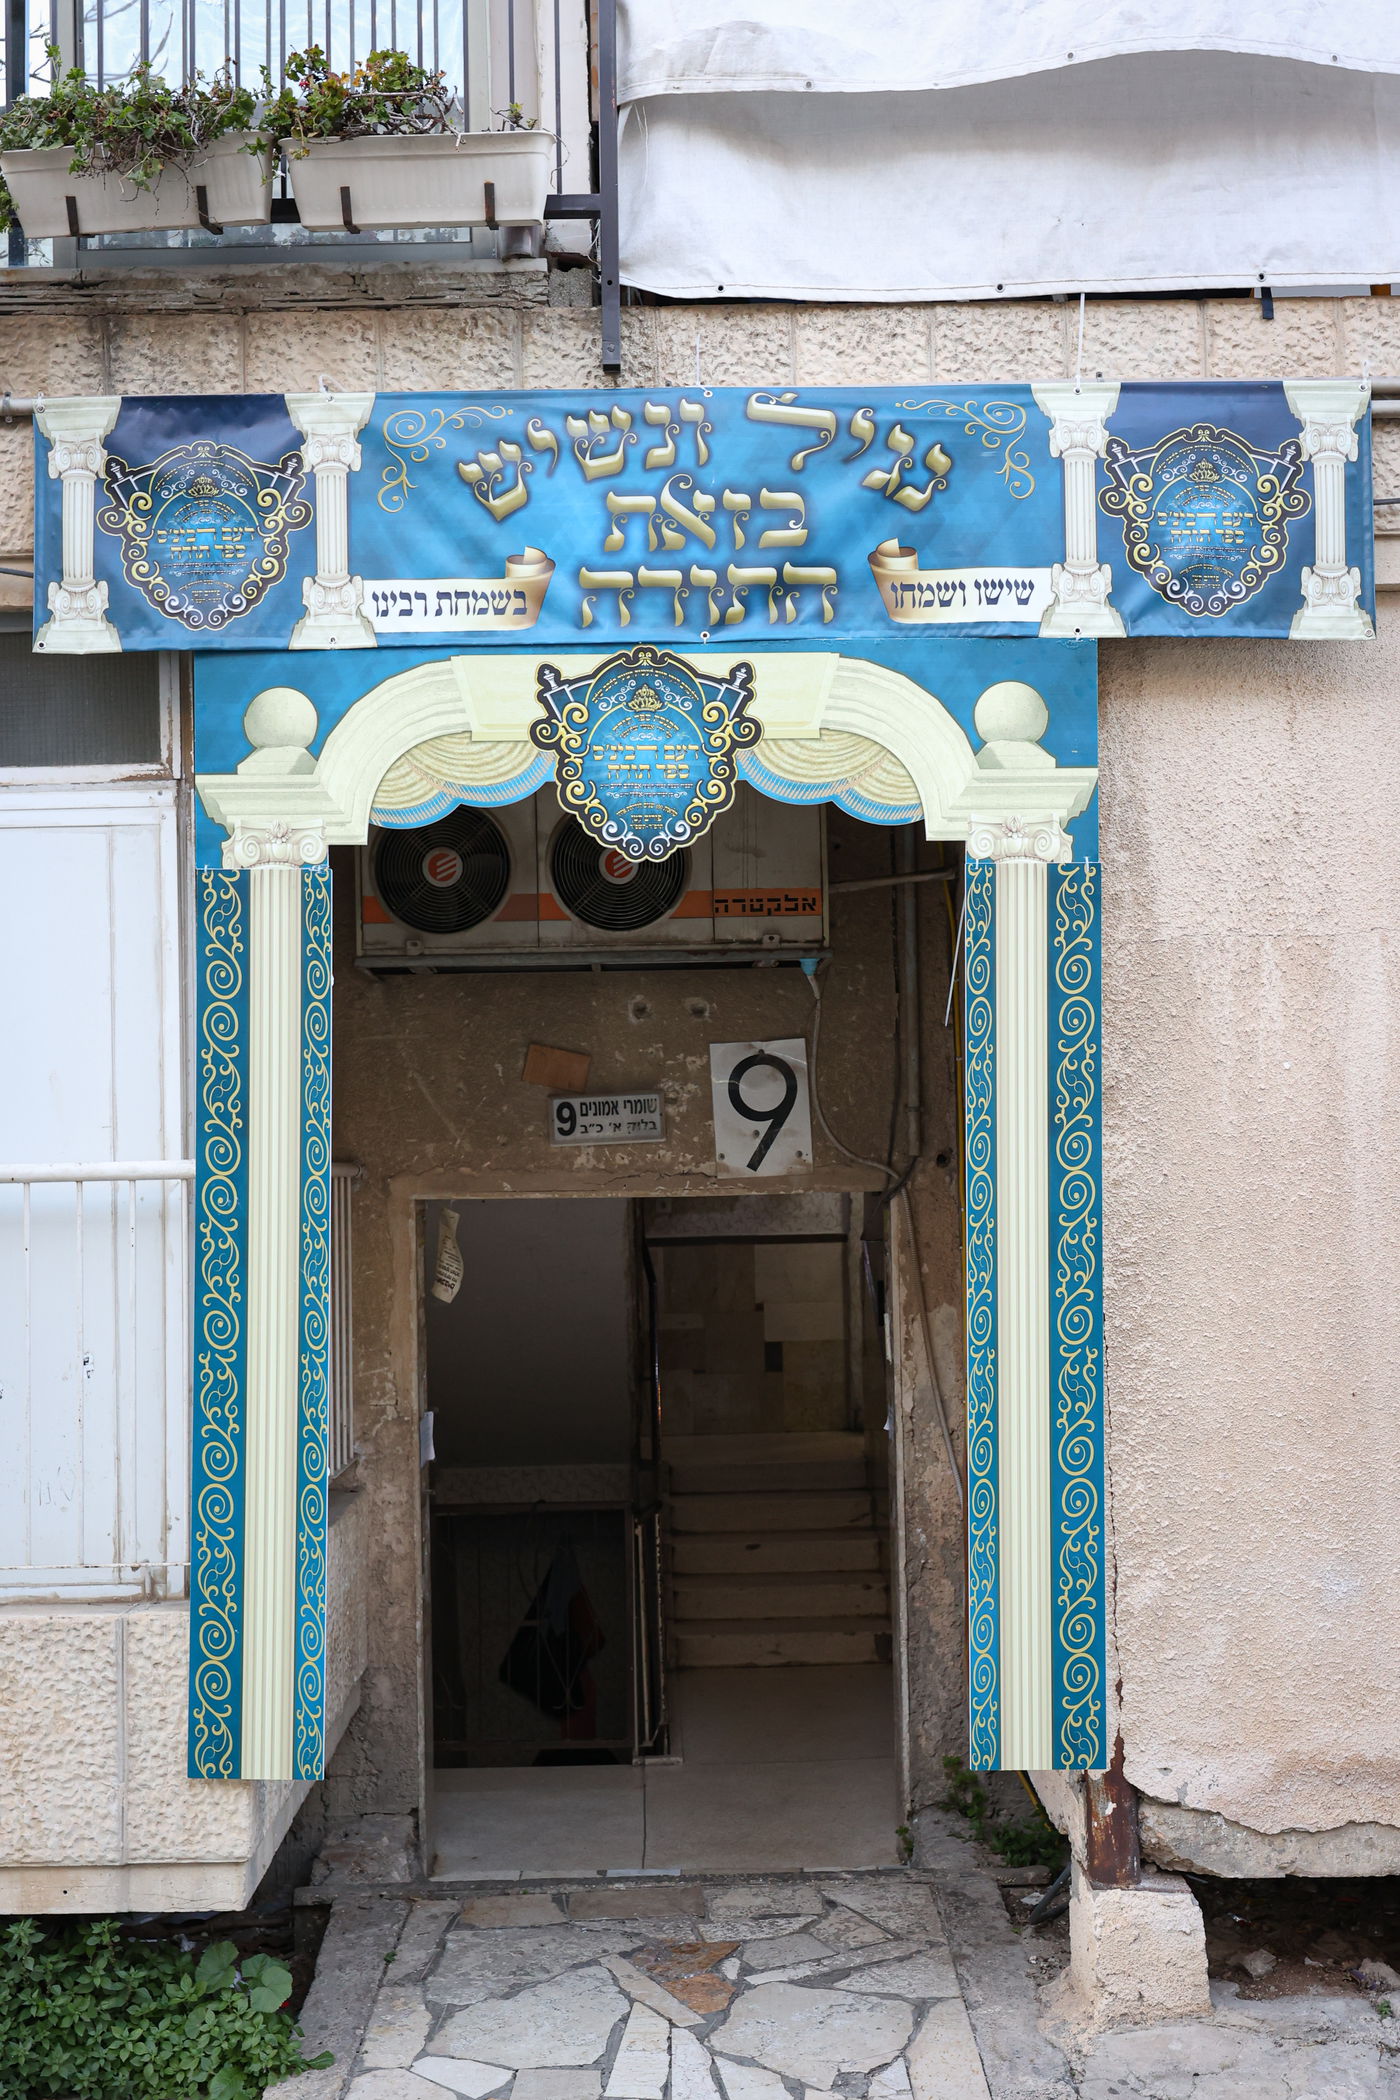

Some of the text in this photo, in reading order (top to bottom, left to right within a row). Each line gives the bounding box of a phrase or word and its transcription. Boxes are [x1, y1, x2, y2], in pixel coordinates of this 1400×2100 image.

[457, 391, 948, 522] נגיל ונשיש
[603, 473, 809, 553] בזאת
[1170, 529, 1245, 544] ספר תורה
[170, 544, 246, 560] ספר תורה
[372, 589, 527, 617] בשמחת רבינו
[577, 561, 839, 629] התורה
[890, 578, 1035, 609] שישו ושמחו
[607, 764, 689, 779] ספר תורה
[714, 894, 816, 916] אלקטרה
[556, 1101, 577, 1137] 9
[580, 1098, 657, 1117] שומרי אמונים
[727, 1053, 798, 1172] 9
